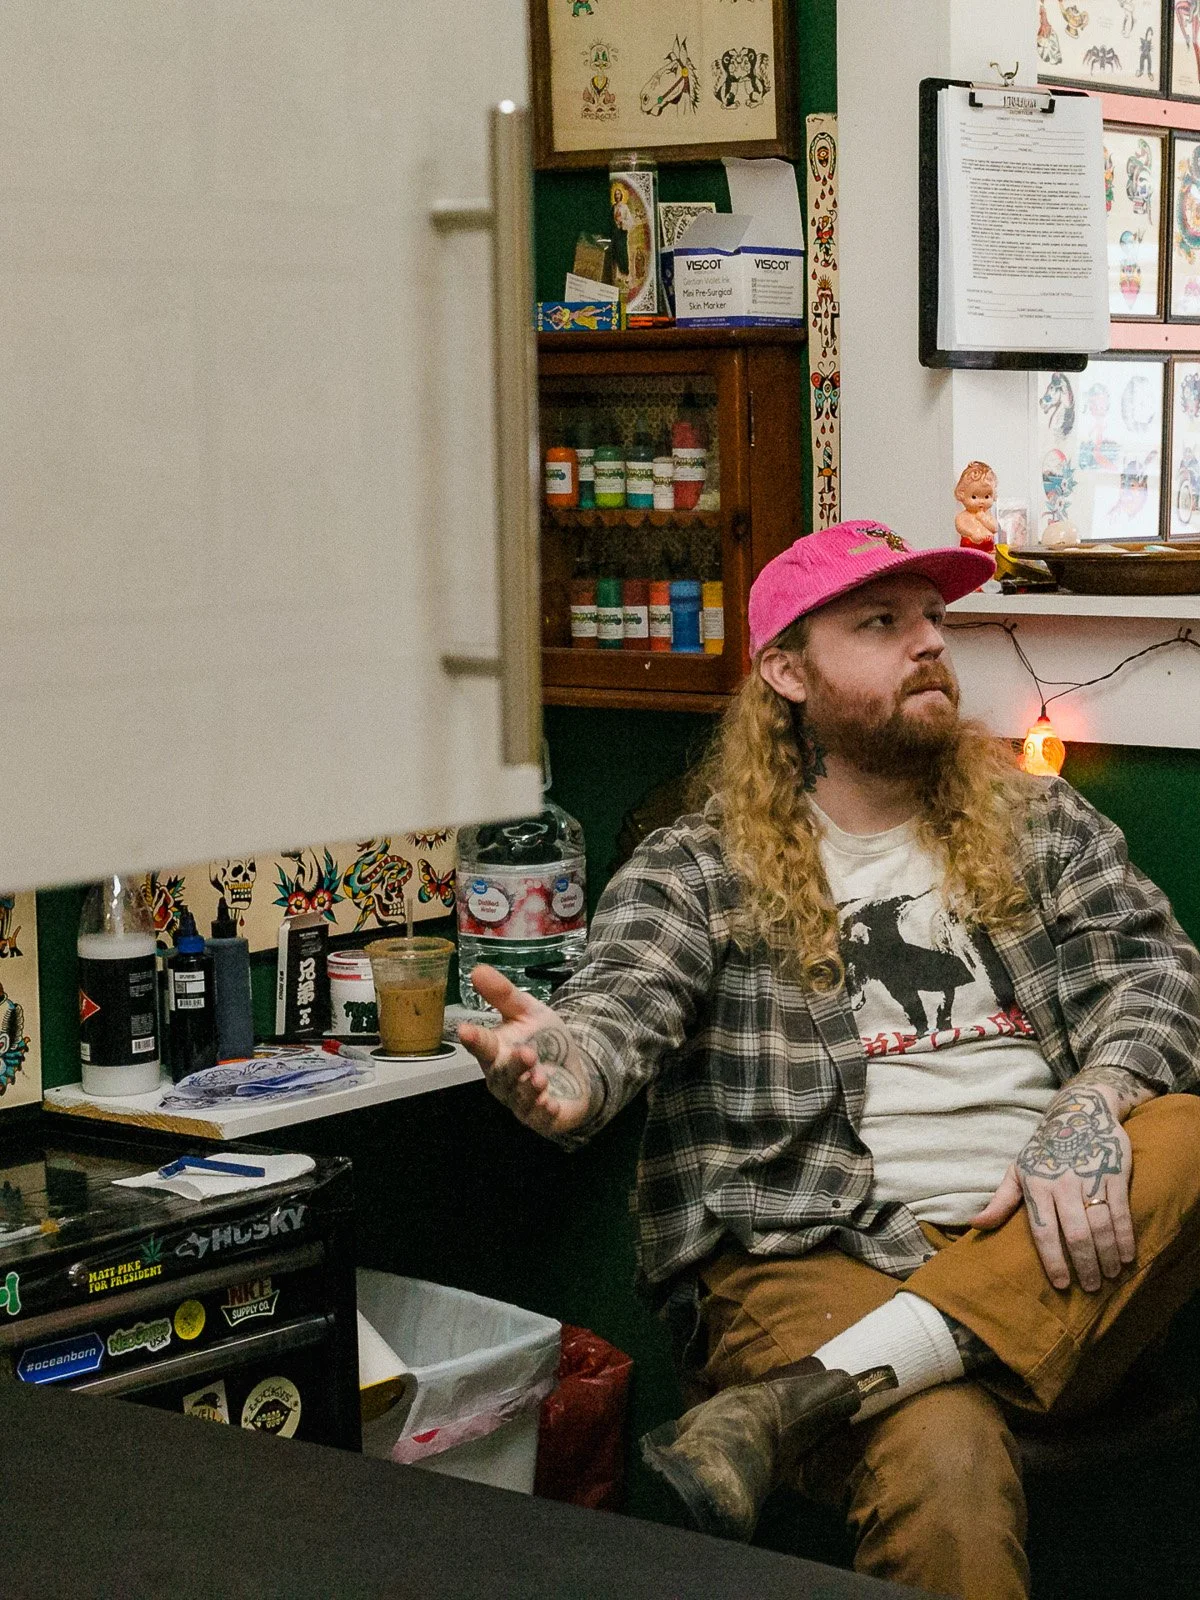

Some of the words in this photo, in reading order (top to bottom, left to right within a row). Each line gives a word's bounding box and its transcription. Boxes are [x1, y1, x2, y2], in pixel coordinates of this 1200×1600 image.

[686, 258, 722, 271] VISCOT
[754, 258, 790, 271] VISCOT
[682, 289, 695, 298] Mini
[695, 287, 733, 299] Pre-Surgical
[688, 302, 702, 311] Skin
[703, 301, 727, 310] Marker
[211, 1205, 307, 1251] HUSKY
[89, 1266, 116, 1284] MATT
[117, 1260, 141, 1276] PIKE
[89, 1280, 109, 1294] FOR
[110, 1265, 163, 1288] PRESIDENT
[232, 1303, 258, 1320] SUPPLY
[149, 1335, 167, 1348] USA
[26, 1347, 97, 1372] #oceanborn
